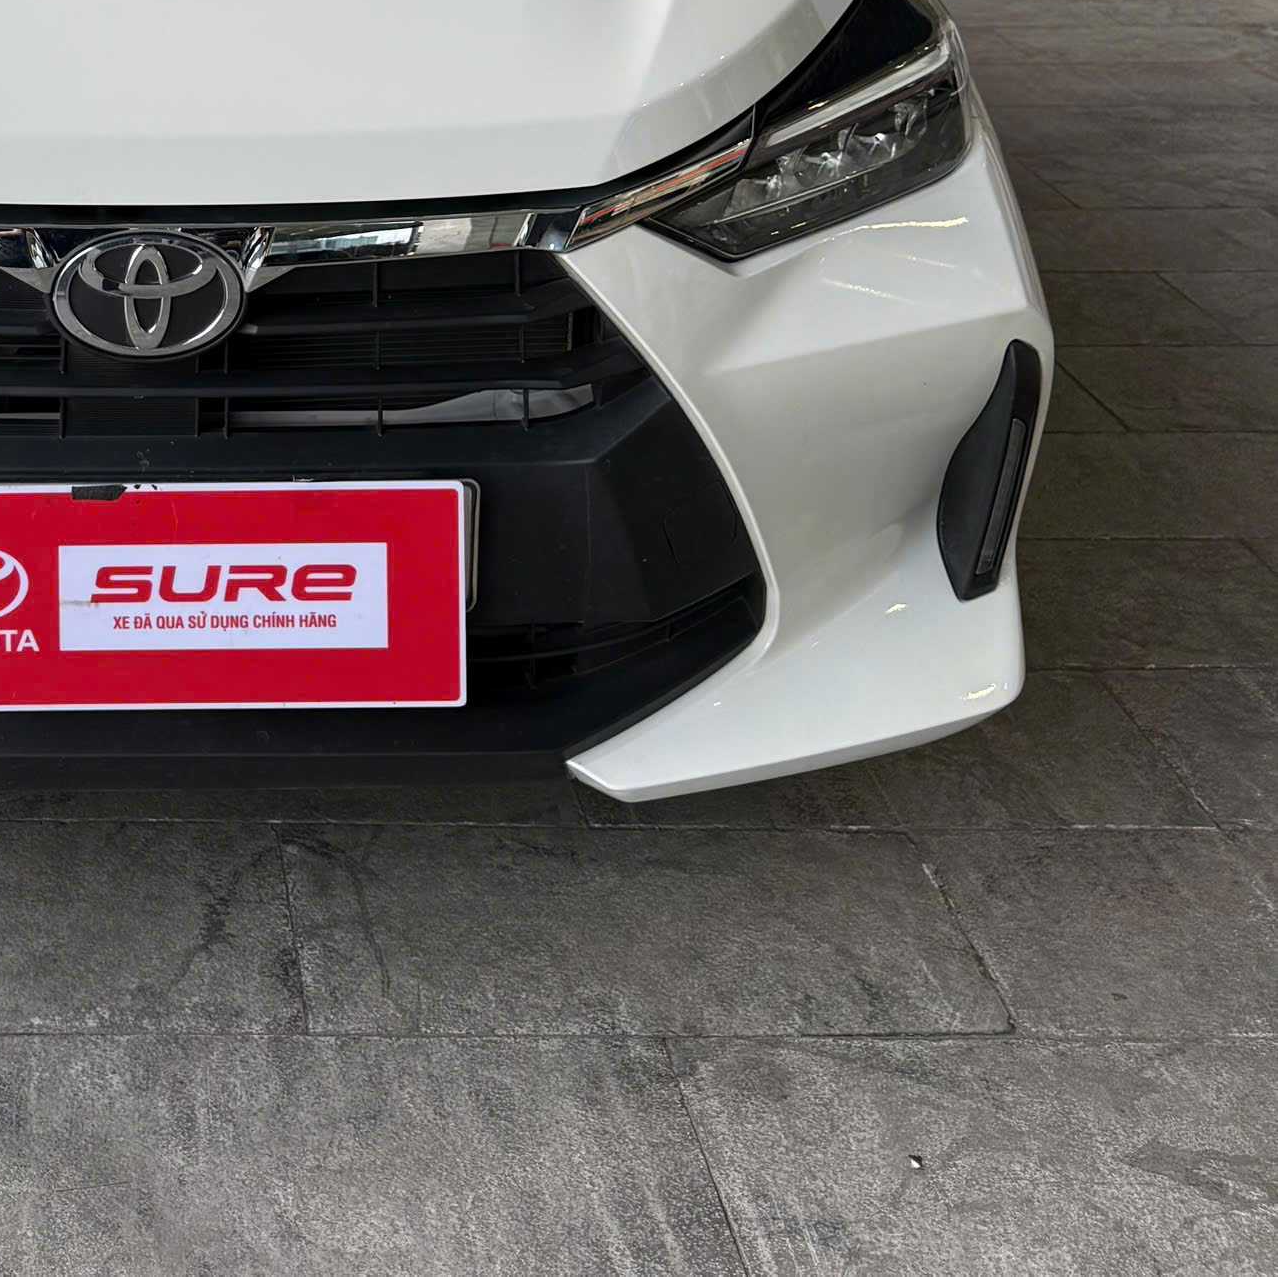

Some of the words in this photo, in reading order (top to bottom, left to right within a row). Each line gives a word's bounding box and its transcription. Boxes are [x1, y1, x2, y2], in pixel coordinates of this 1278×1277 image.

[113, 615, 130, 630] XE
[133, 612, 152, 630] ĐÃ
[156, 615, 185, 629] QUA
[188, 610, 208, 629] SỬ
[210, 614, 249, 631] DỤNG
[252, 611, 295, 629] CHÍNH
[299, 611, 337, 628] HÃNG
